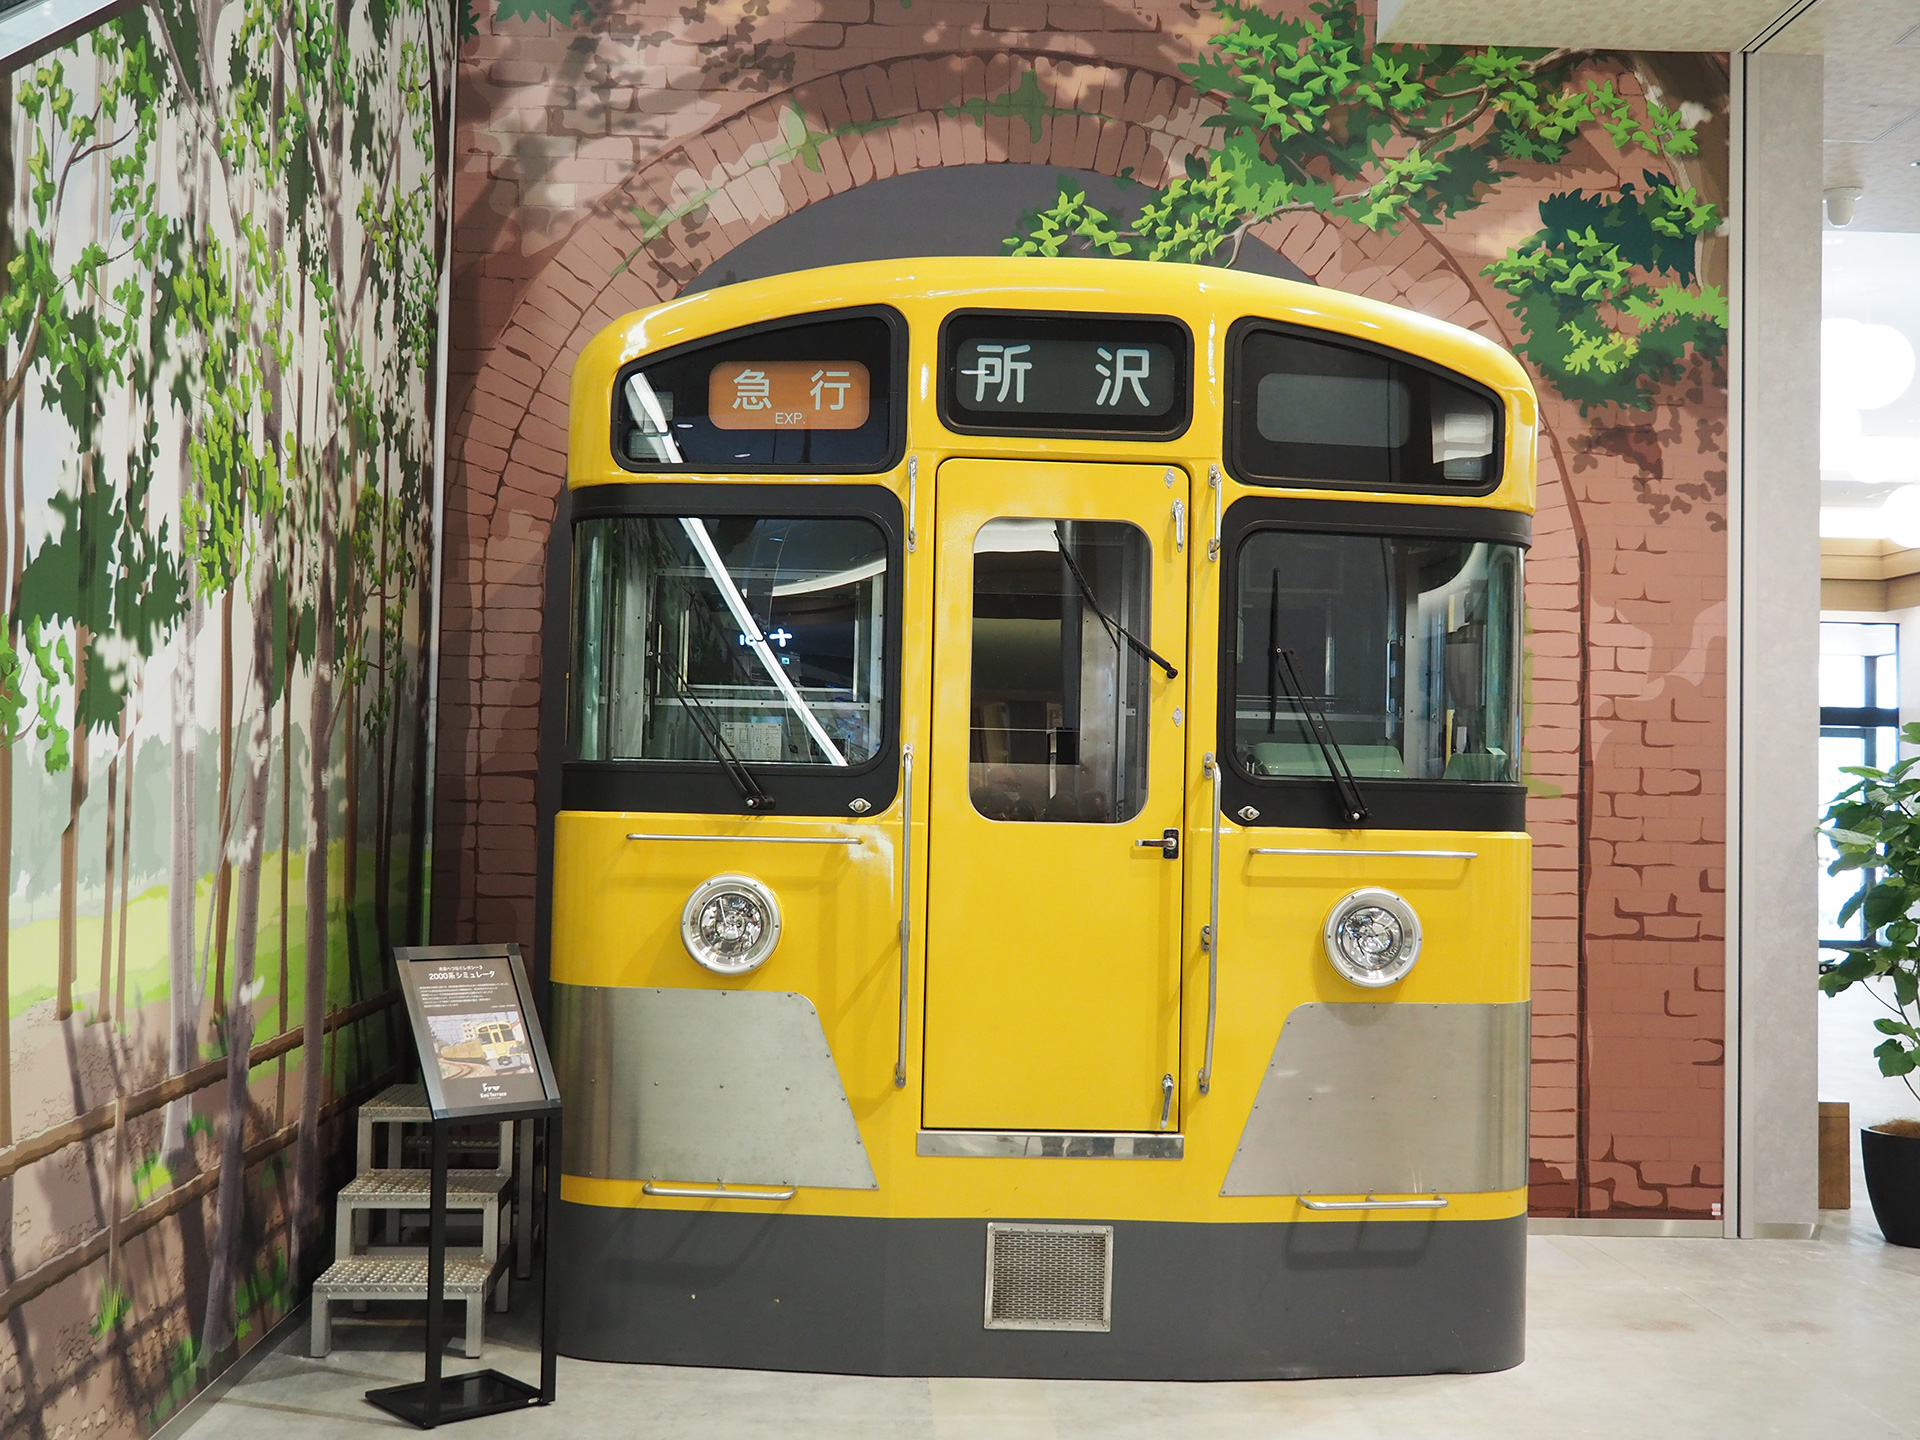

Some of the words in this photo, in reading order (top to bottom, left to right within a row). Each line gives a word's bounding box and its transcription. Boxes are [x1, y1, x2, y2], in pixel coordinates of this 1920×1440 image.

[732, 369, 851, 411] 急行
[975, 344, 1150, 406] 所沢
[775, 412, 806, 425] EXP.
